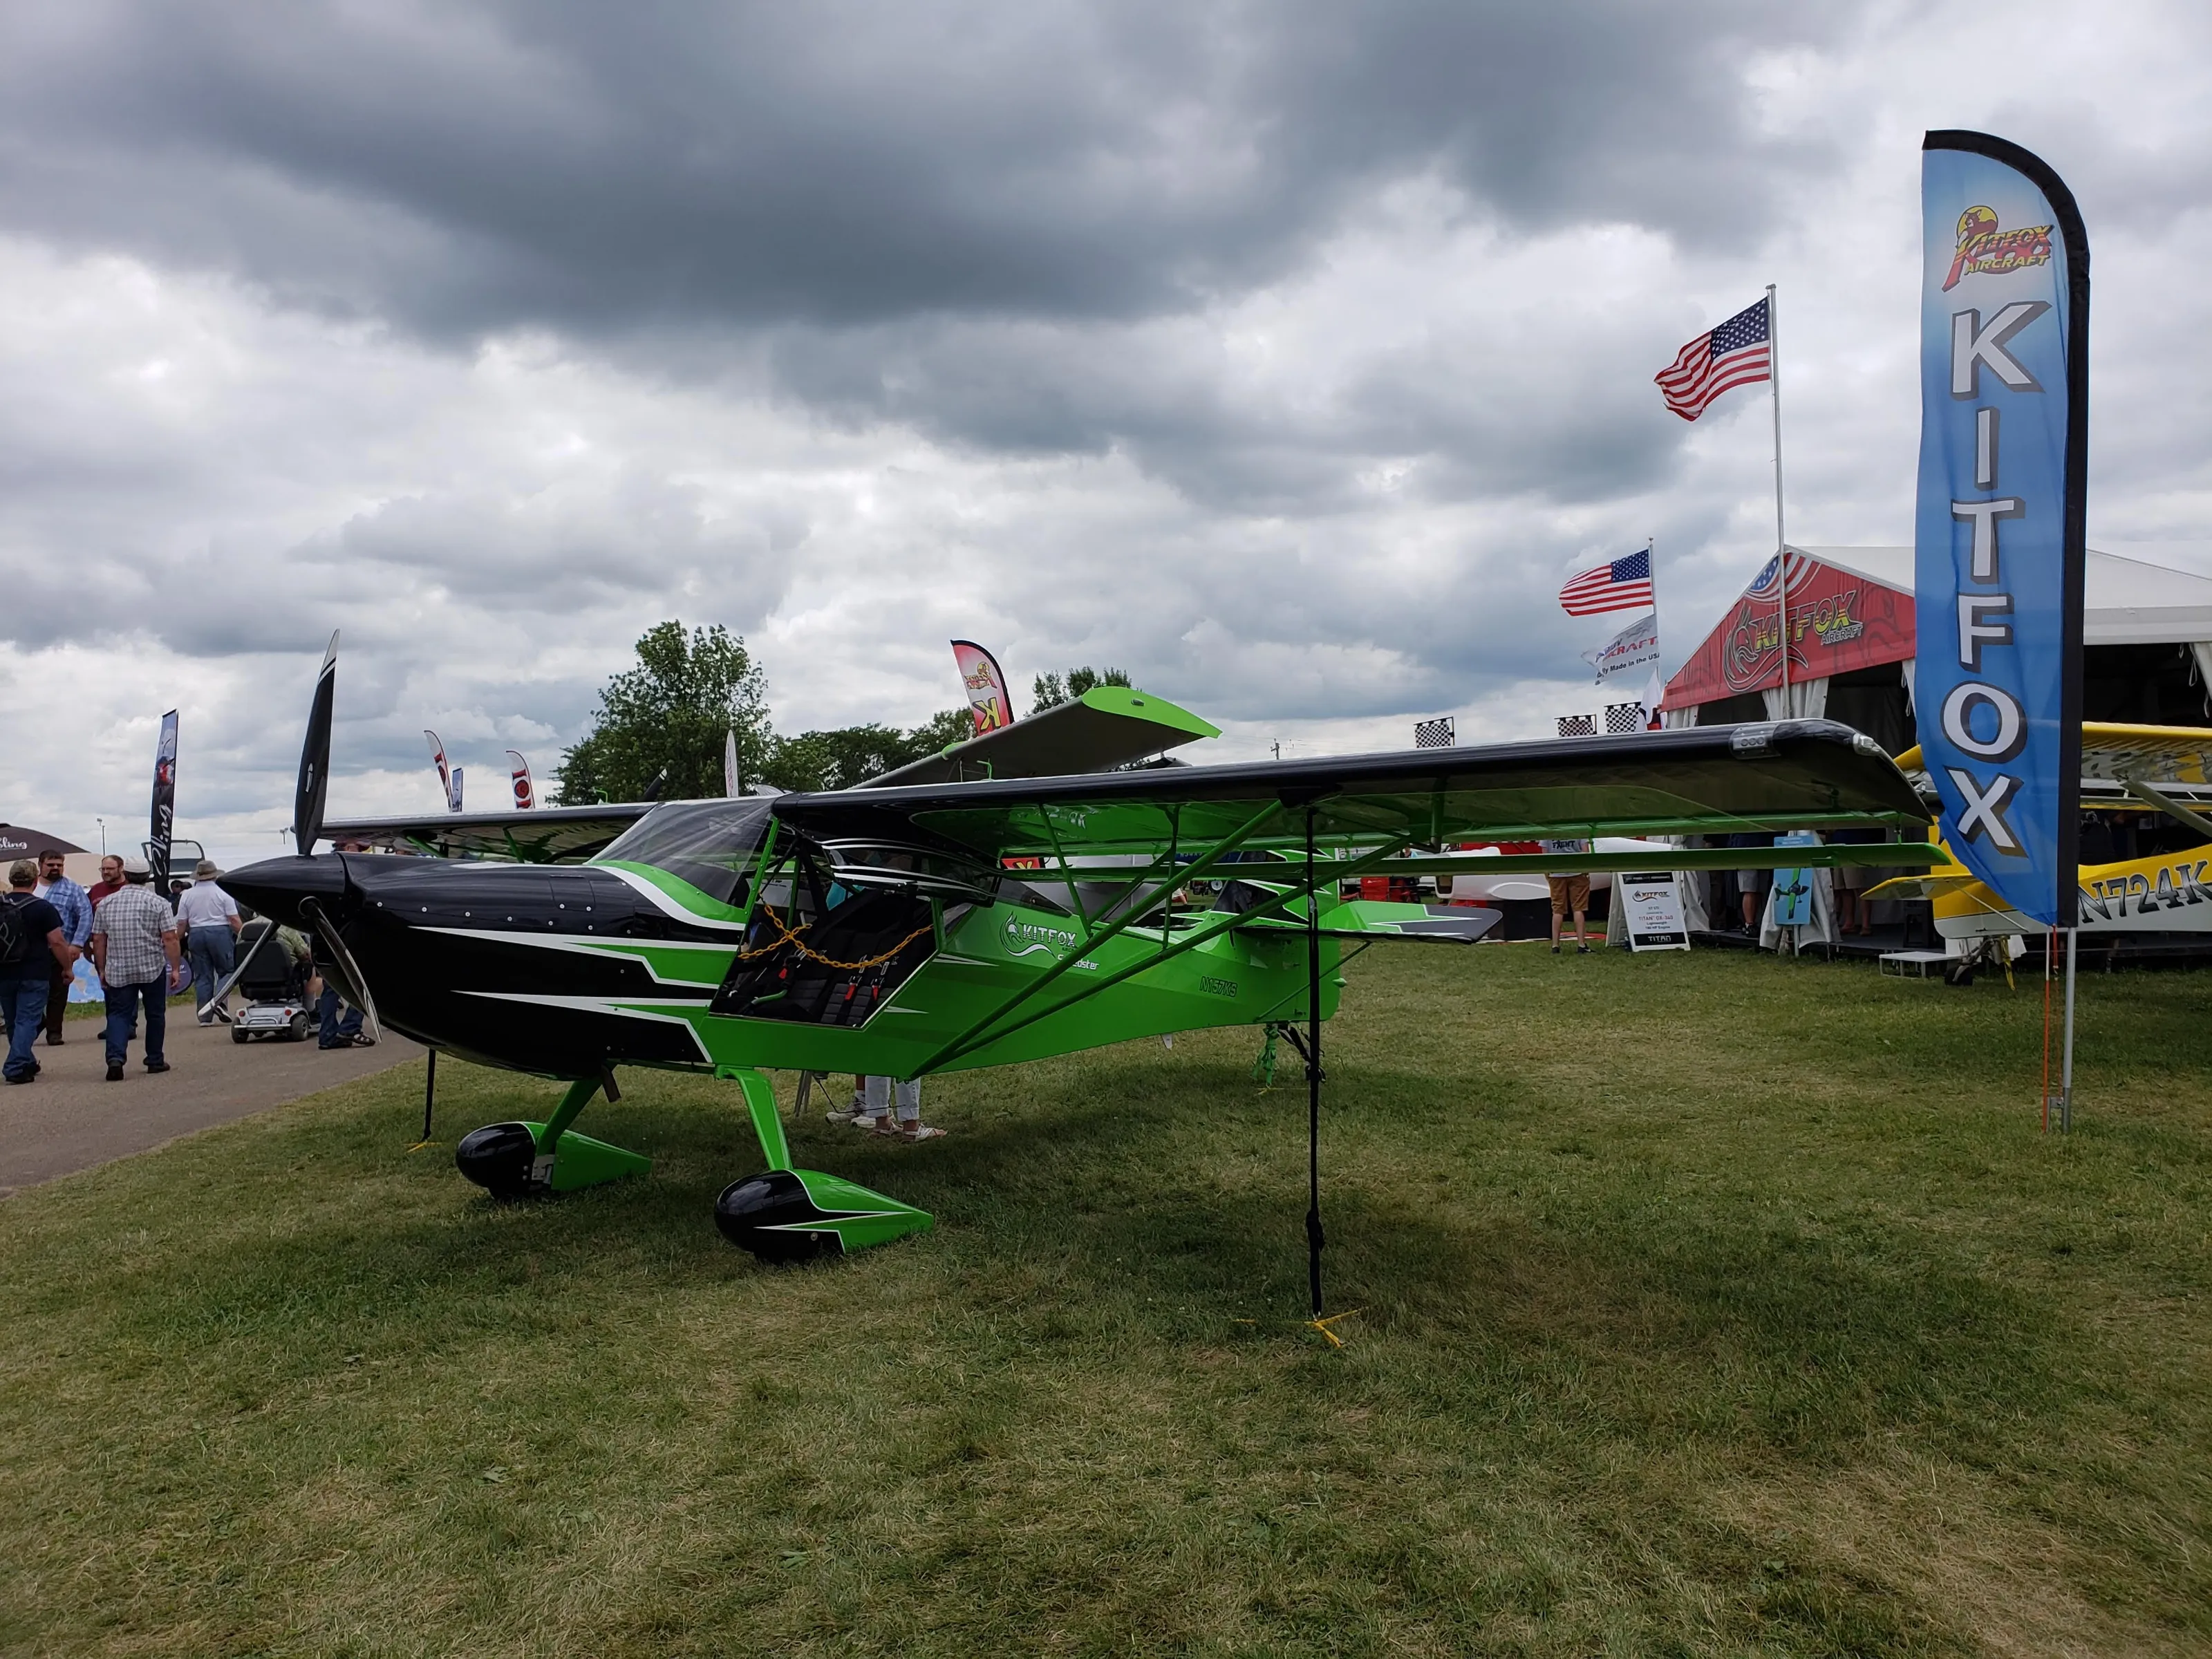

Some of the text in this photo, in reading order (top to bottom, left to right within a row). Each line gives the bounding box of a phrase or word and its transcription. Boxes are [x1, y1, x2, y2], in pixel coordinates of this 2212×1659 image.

[1942, 224, 2054, 292] KITFOX
[1964, 254, 2050, 275] AIRCRAFT
[1940, 301, 2052, 858] KITFOX
[1749, 590, 1863, 653] KITFOX
[1820, 624, 1863, 646] AIRCRAFT
[1609, 663, 1627, 672] Made
[1636, 656, 1647, 664] the
[2078, 861, 2212, 924] N724K
[1020, 923, 1078, 947] KITFOX
